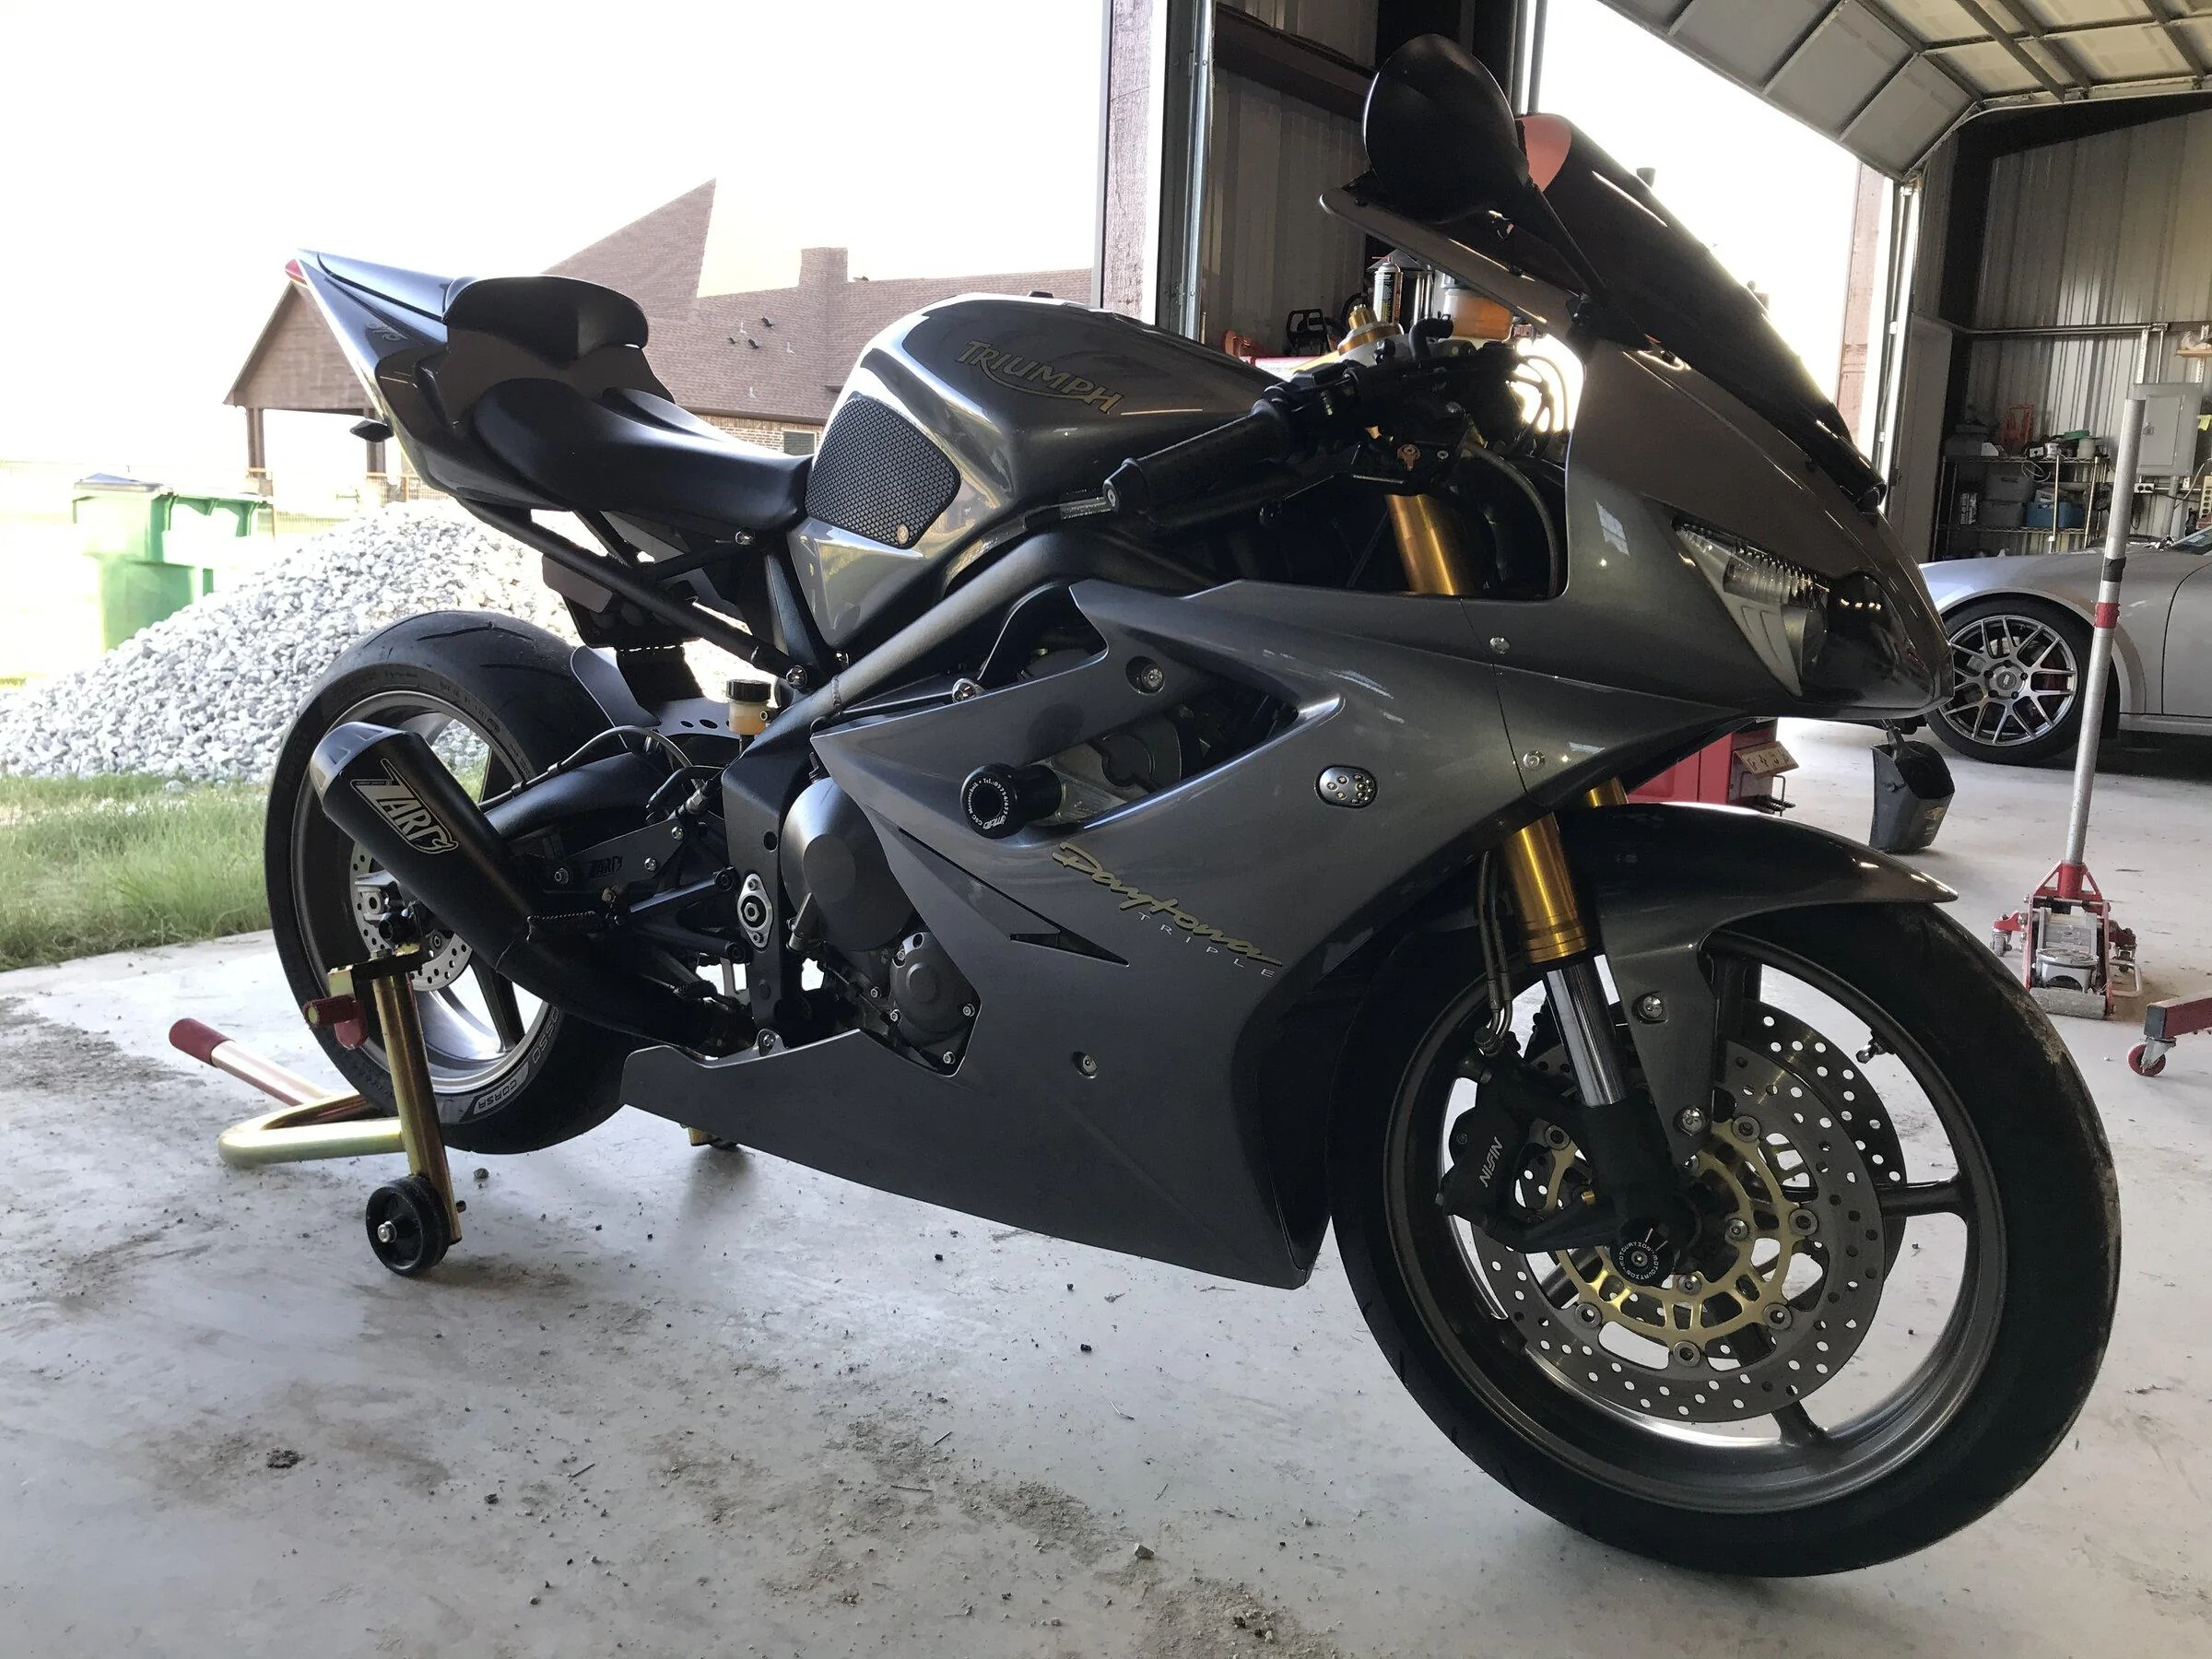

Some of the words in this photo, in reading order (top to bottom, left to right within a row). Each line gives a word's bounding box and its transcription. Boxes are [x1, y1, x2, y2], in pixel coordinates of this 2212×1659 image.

[955, 339, 1124, 414] TRIUMPH
[1052, 841, 1283, 967] Daytona
[1137, 911, 1276, 978] TRIPLE
[477, 1078, 517, 1109] CORSA
